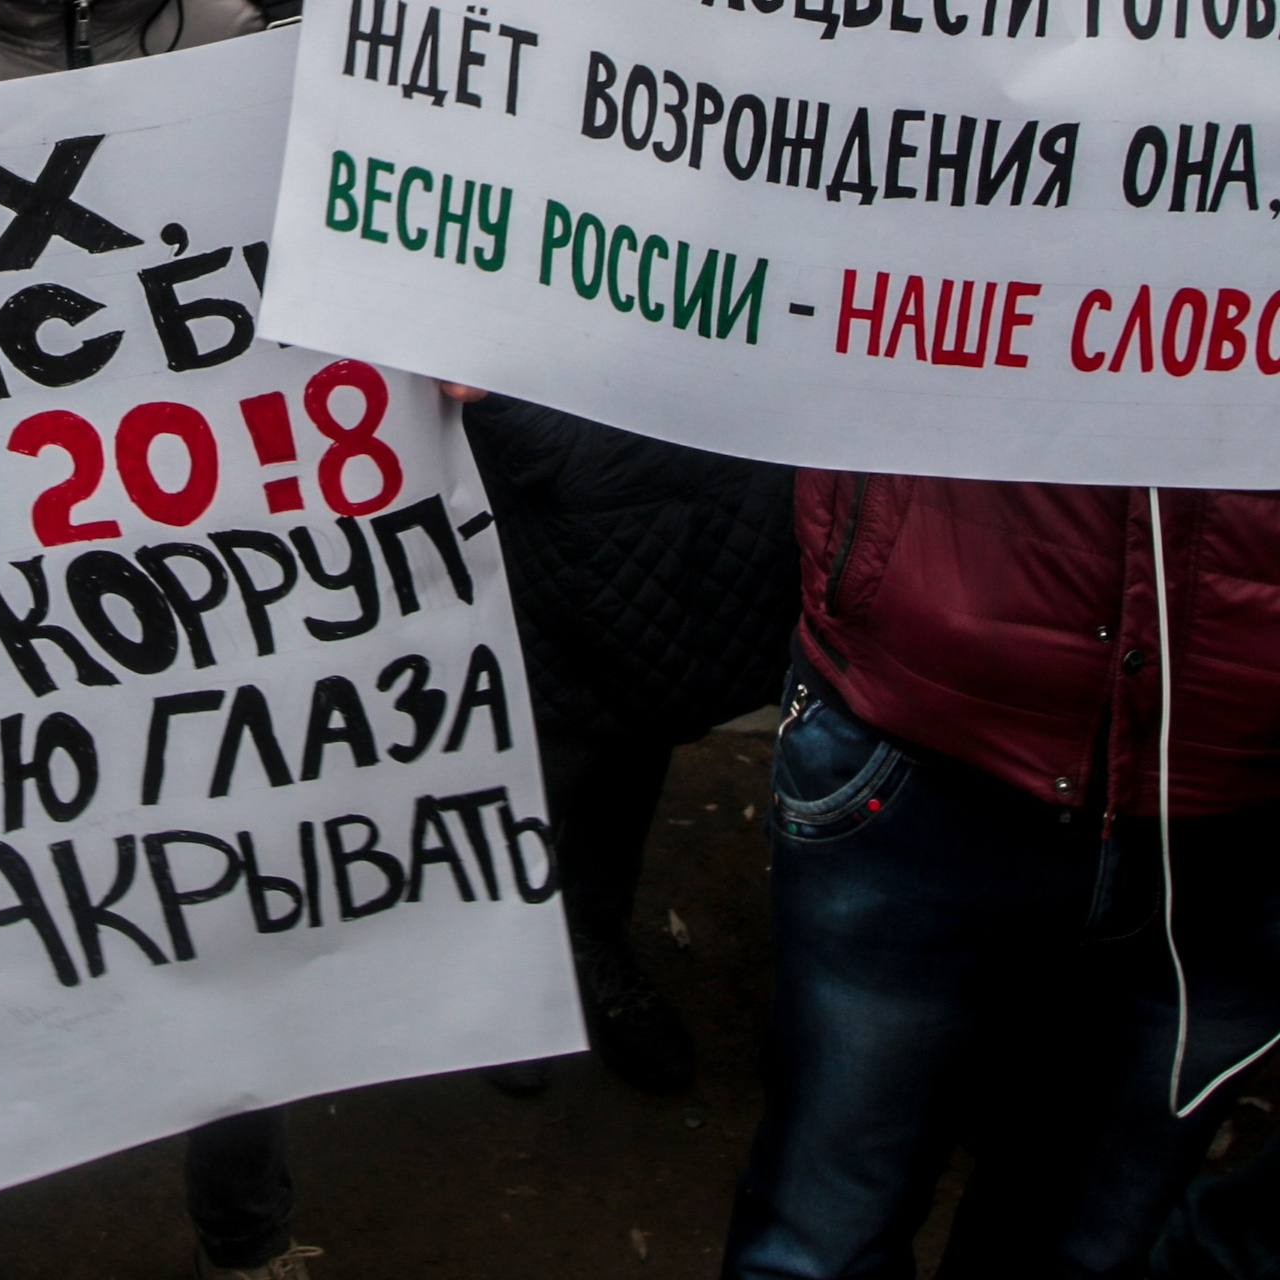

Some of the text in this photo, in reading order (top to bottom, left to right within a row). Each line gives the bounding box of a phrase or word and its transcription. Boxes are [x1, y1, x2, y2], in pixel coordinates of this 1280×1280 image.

[582, 51, 1080, 208] ВОЗРОЖДЕНИЯ
[1123, 122, 1280, 220] ОНА,
[326, 151, 512, 271] ВЕСНУ
[540, 200, 768, 345] РОССИИ
[836, 269, 1042, 368] НАШЕ
[8, 359, 403, 546] 20!8
[141, 644, 513, 805] ГЛАЗА
